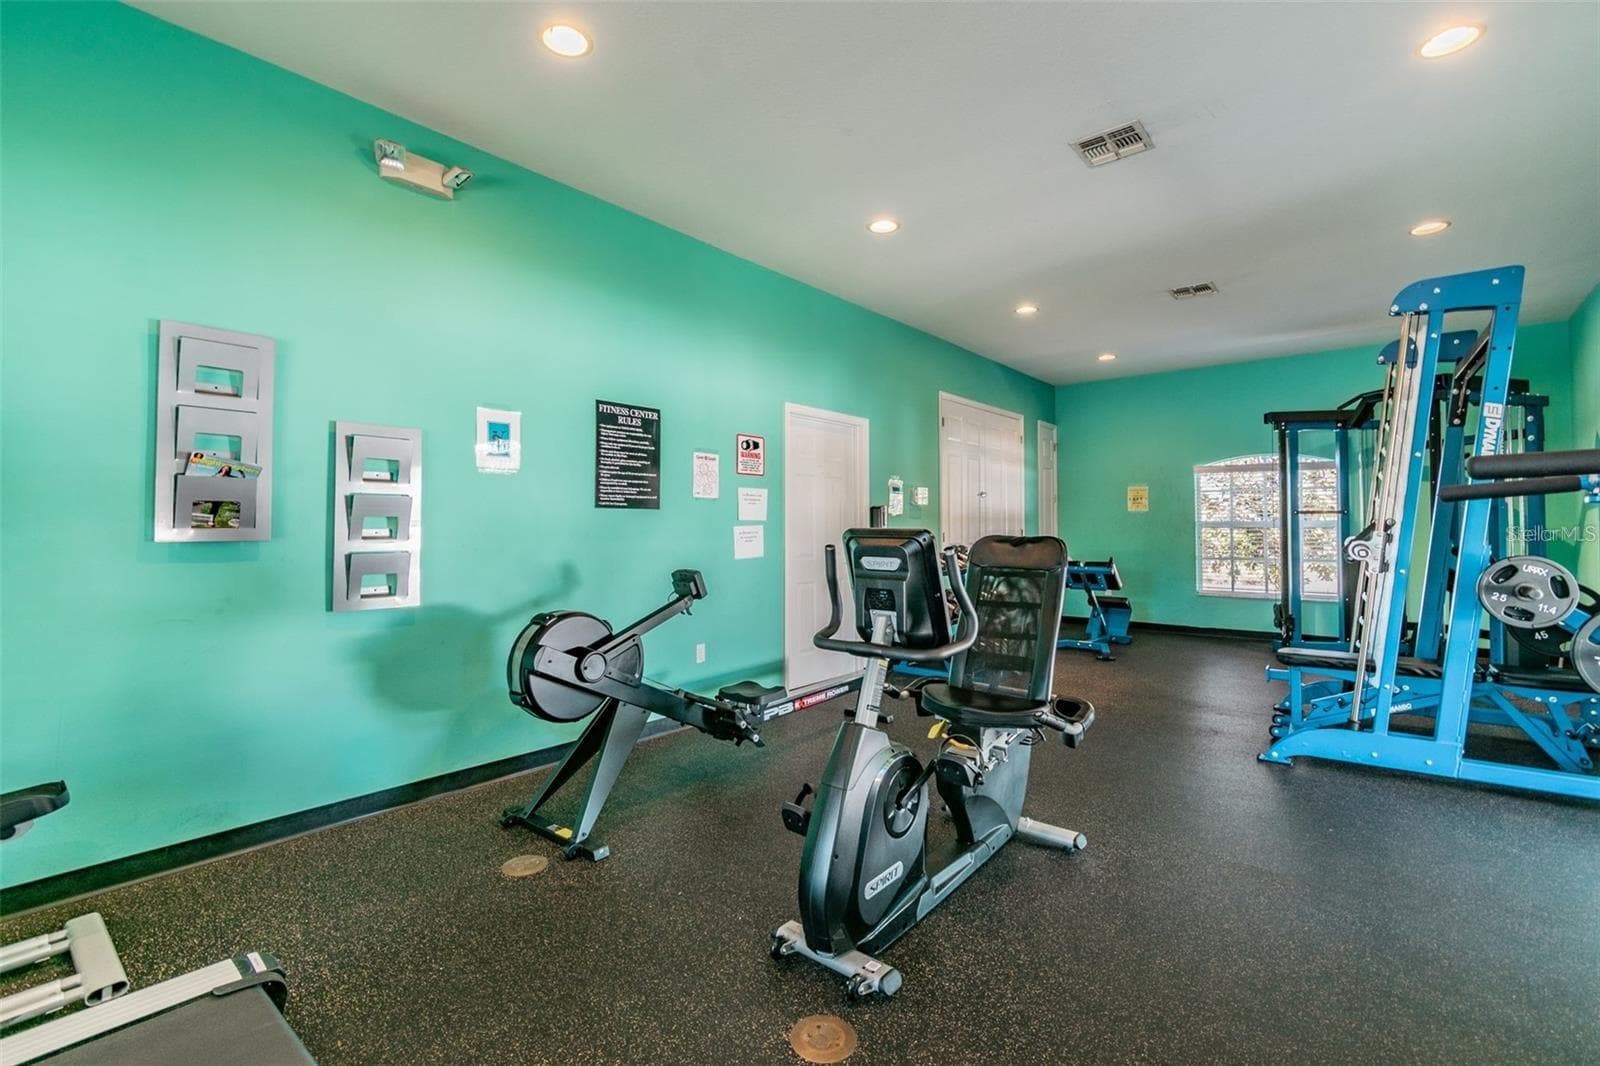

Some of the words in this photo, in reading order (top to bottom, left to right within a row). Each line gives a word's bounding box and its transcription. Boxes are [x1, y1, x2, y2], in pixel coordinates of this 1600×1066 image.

[599, 403, 630, 416] FITNESS
[630, 408, 659, 420] CENTER
[617, 415, 642, 426] RULES
[1481, 417, 1501, 457] DYNA
[1537, 603, 1558, 616] 11.4
[1534, 630, 1550, 641] 45
[869, 866, 899, 892] SPIRIT
